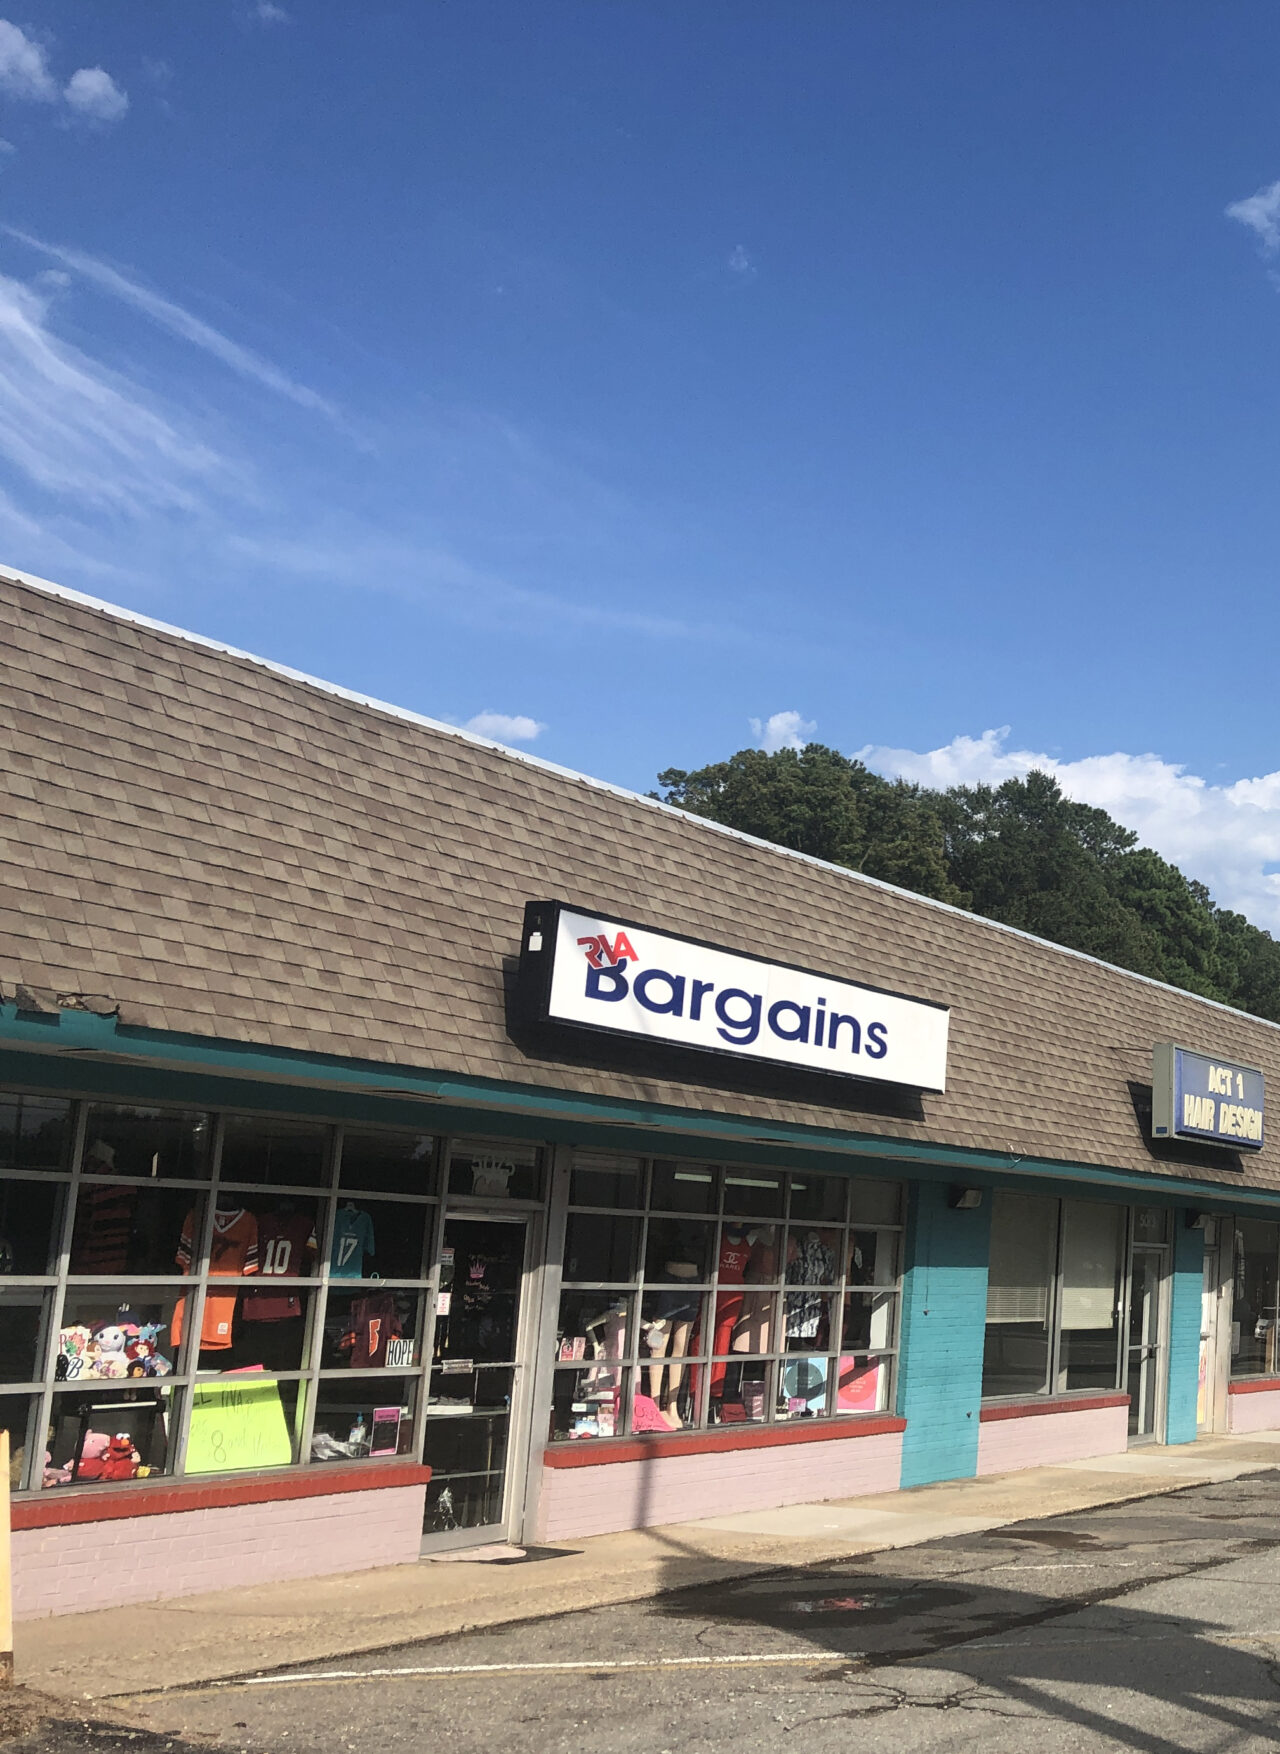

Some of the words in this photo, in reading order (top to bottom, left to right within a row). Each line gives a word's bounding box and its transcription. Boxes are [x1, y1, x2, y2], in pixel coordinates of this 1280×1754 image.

[577, 931, 639, 970] RVA
[585, 950, 888, 1060] Bargains
[1208, 1065, 1233, 1096] ACT
[1236, 1073, 1244, 1100] 1
[1183, 1094, 1216, 1132] HAIR
[1218, 1102, 1263, 1141] DESIGN
[262, 1239, 292, 1274] 10
[336, 1236, 358, 1267] 17
[386, 1340, 413, 1366] HOPE
